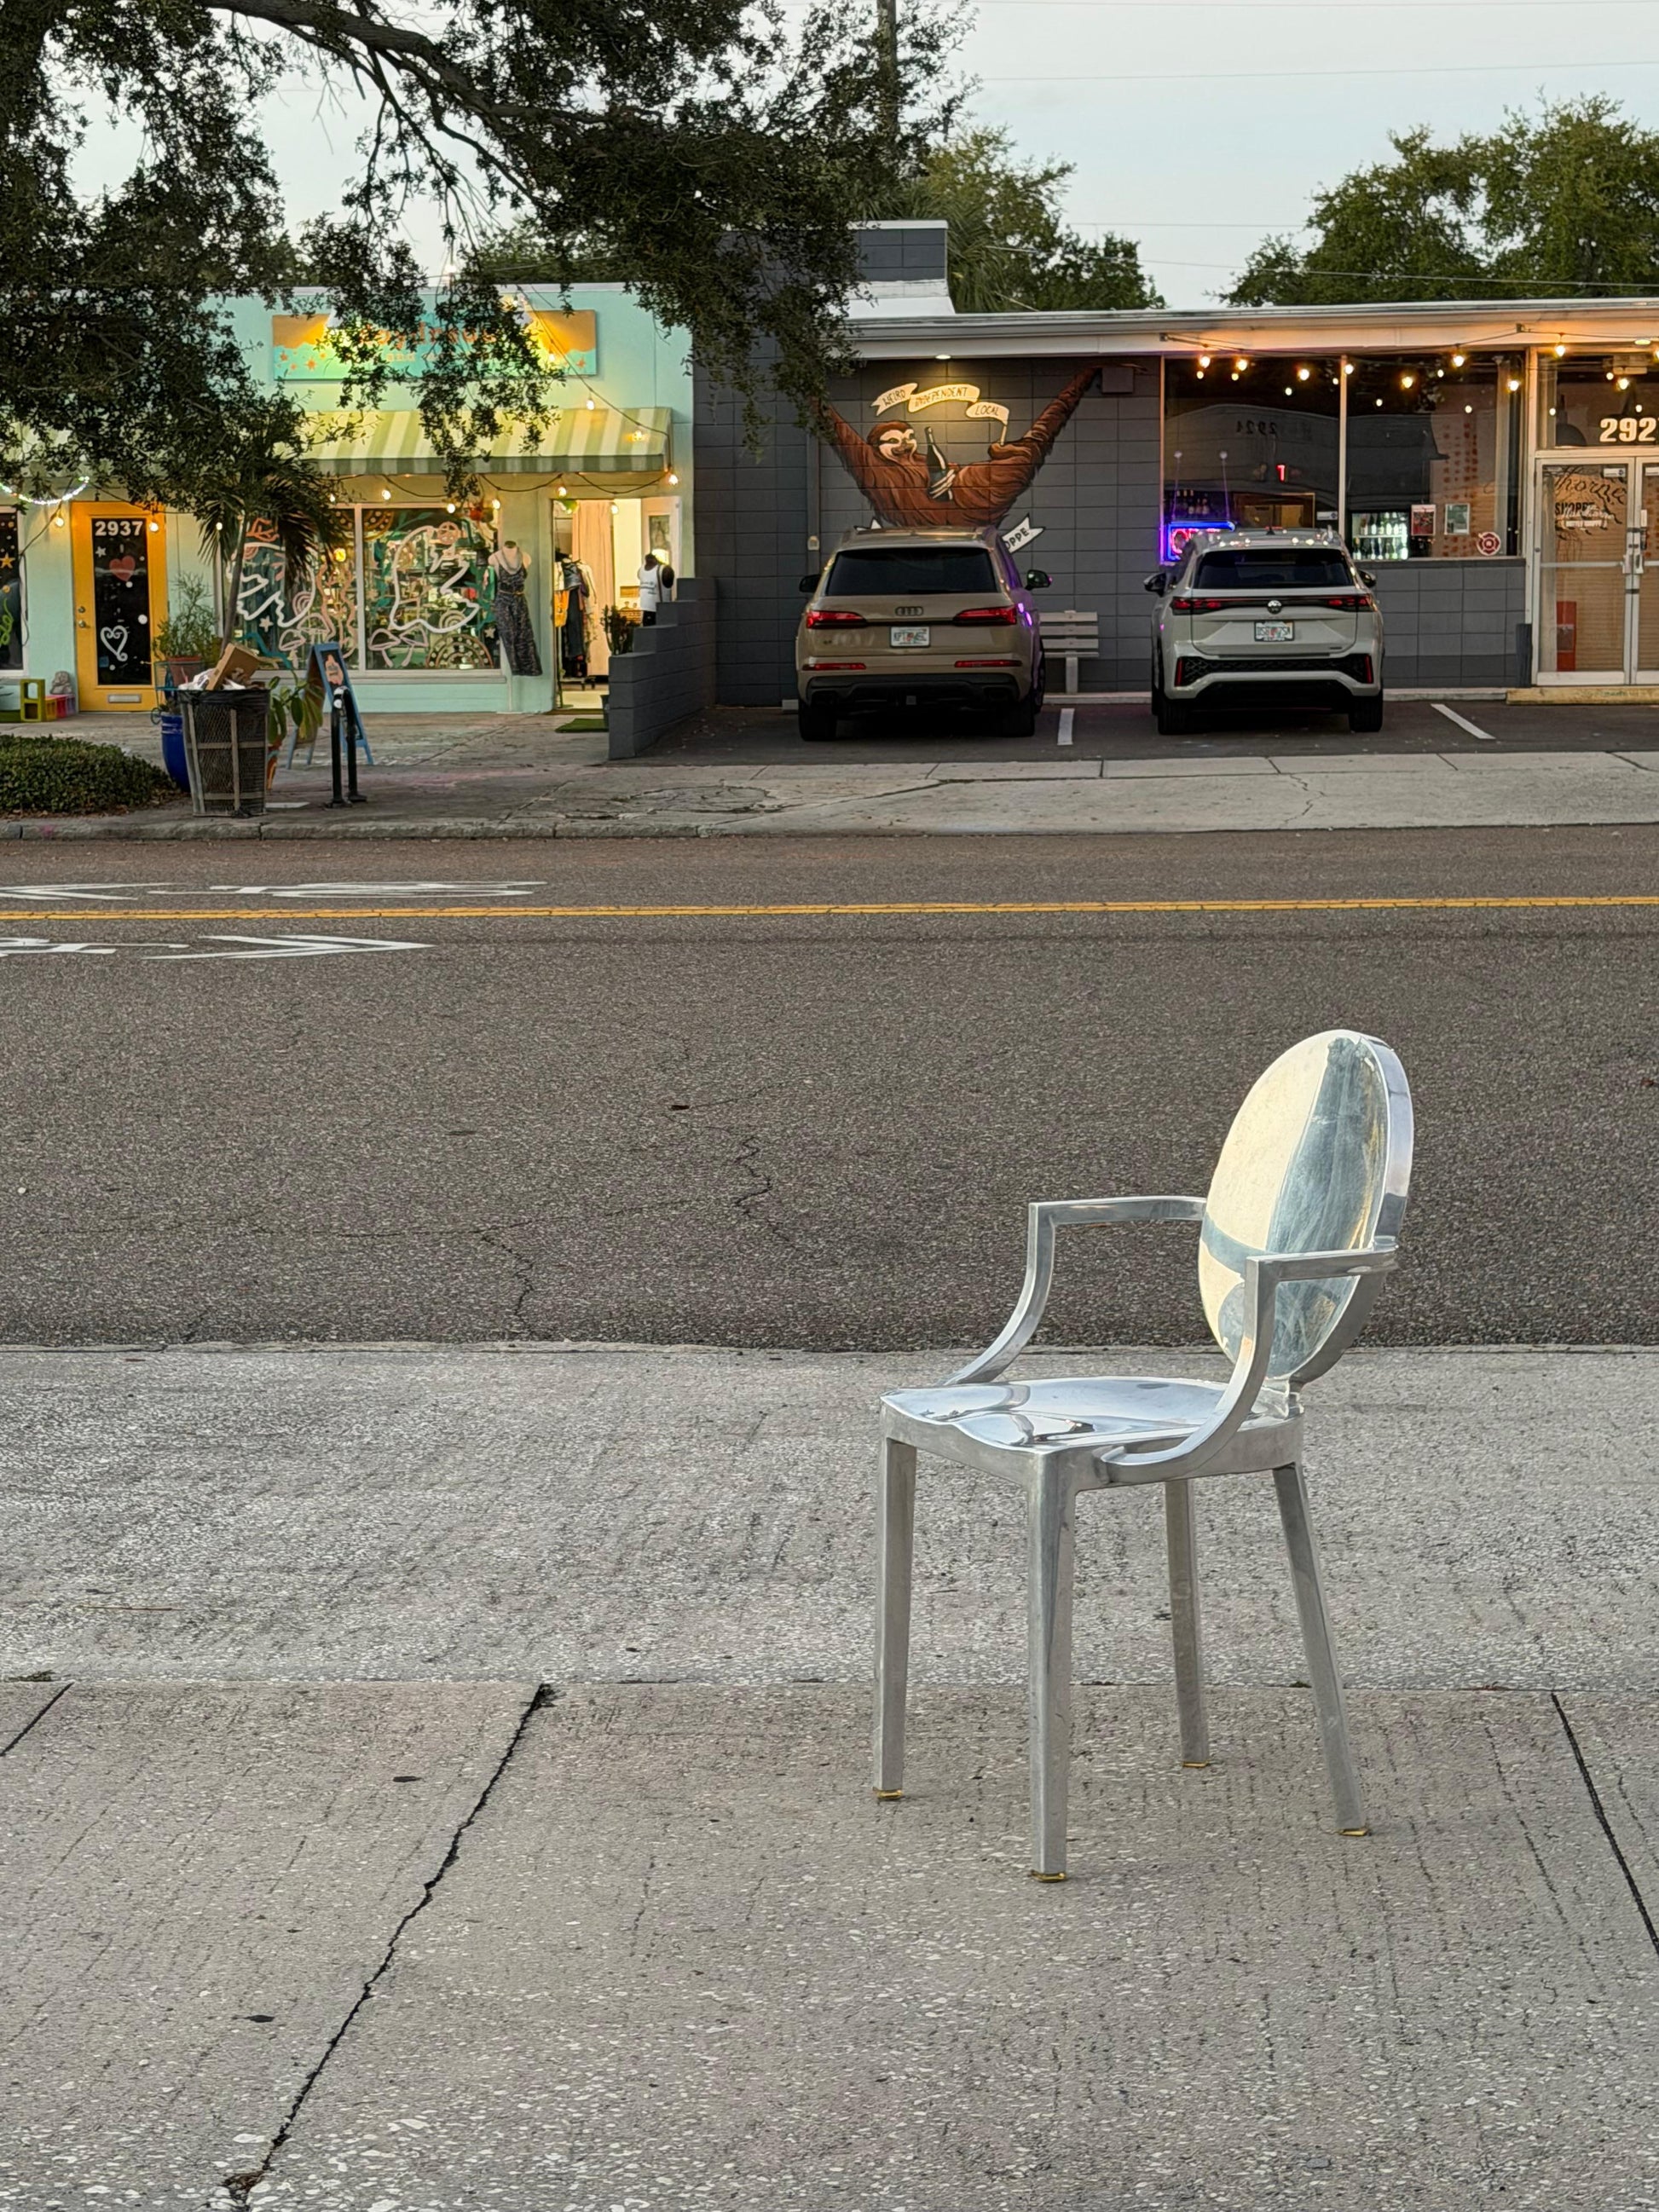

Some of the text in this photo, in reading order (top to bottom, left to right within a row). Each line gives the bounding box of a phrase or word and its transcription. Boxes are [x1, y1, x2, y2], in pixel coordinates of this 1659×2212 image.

[882, 389, 906, 407] WEIRD
[974, 405, 999, 416] LOCAL
[1599, 417, 1659, 442] 292
[95, 520, 143, 536] 2937
